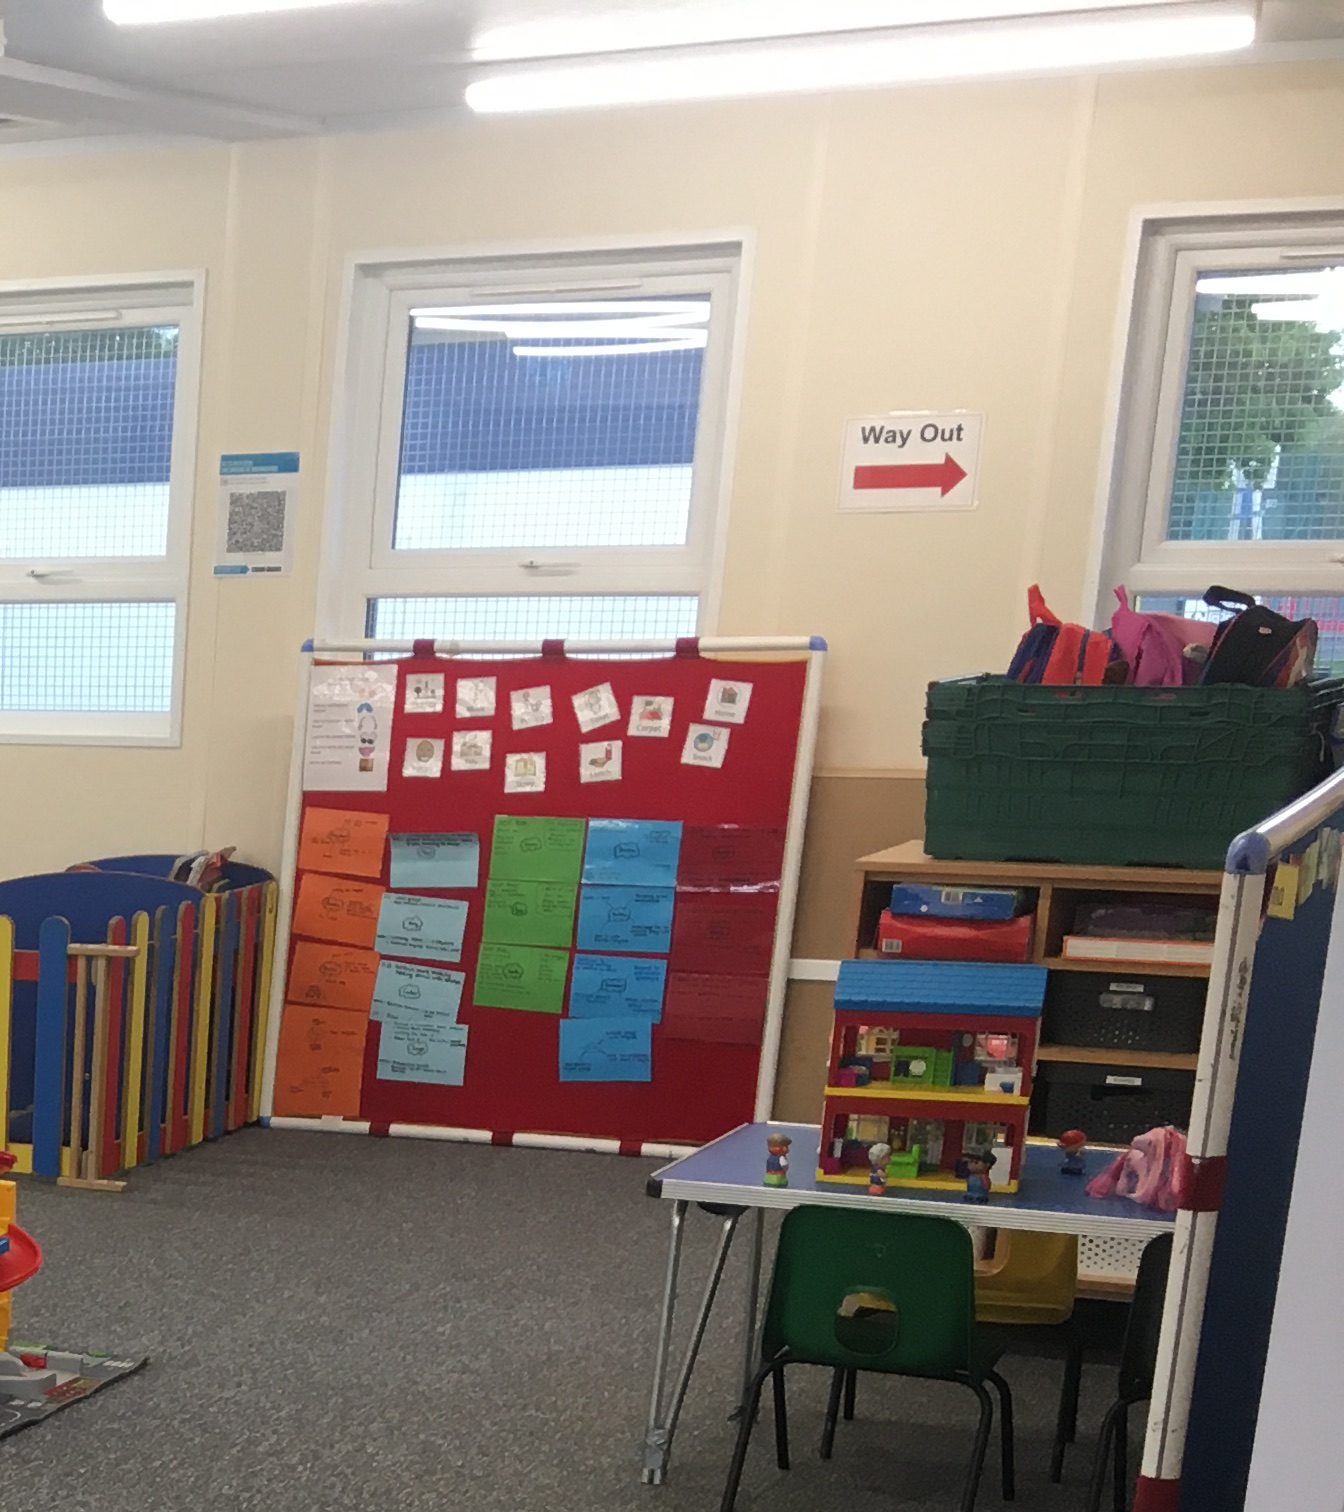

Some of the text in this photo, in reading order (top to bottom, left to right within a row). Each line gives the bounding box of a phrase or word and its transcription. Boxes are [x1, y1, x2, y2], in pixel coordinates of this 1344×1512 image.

[861, 423, 964, 448] Way Out
[636, 723, 662, 733] Carpet
